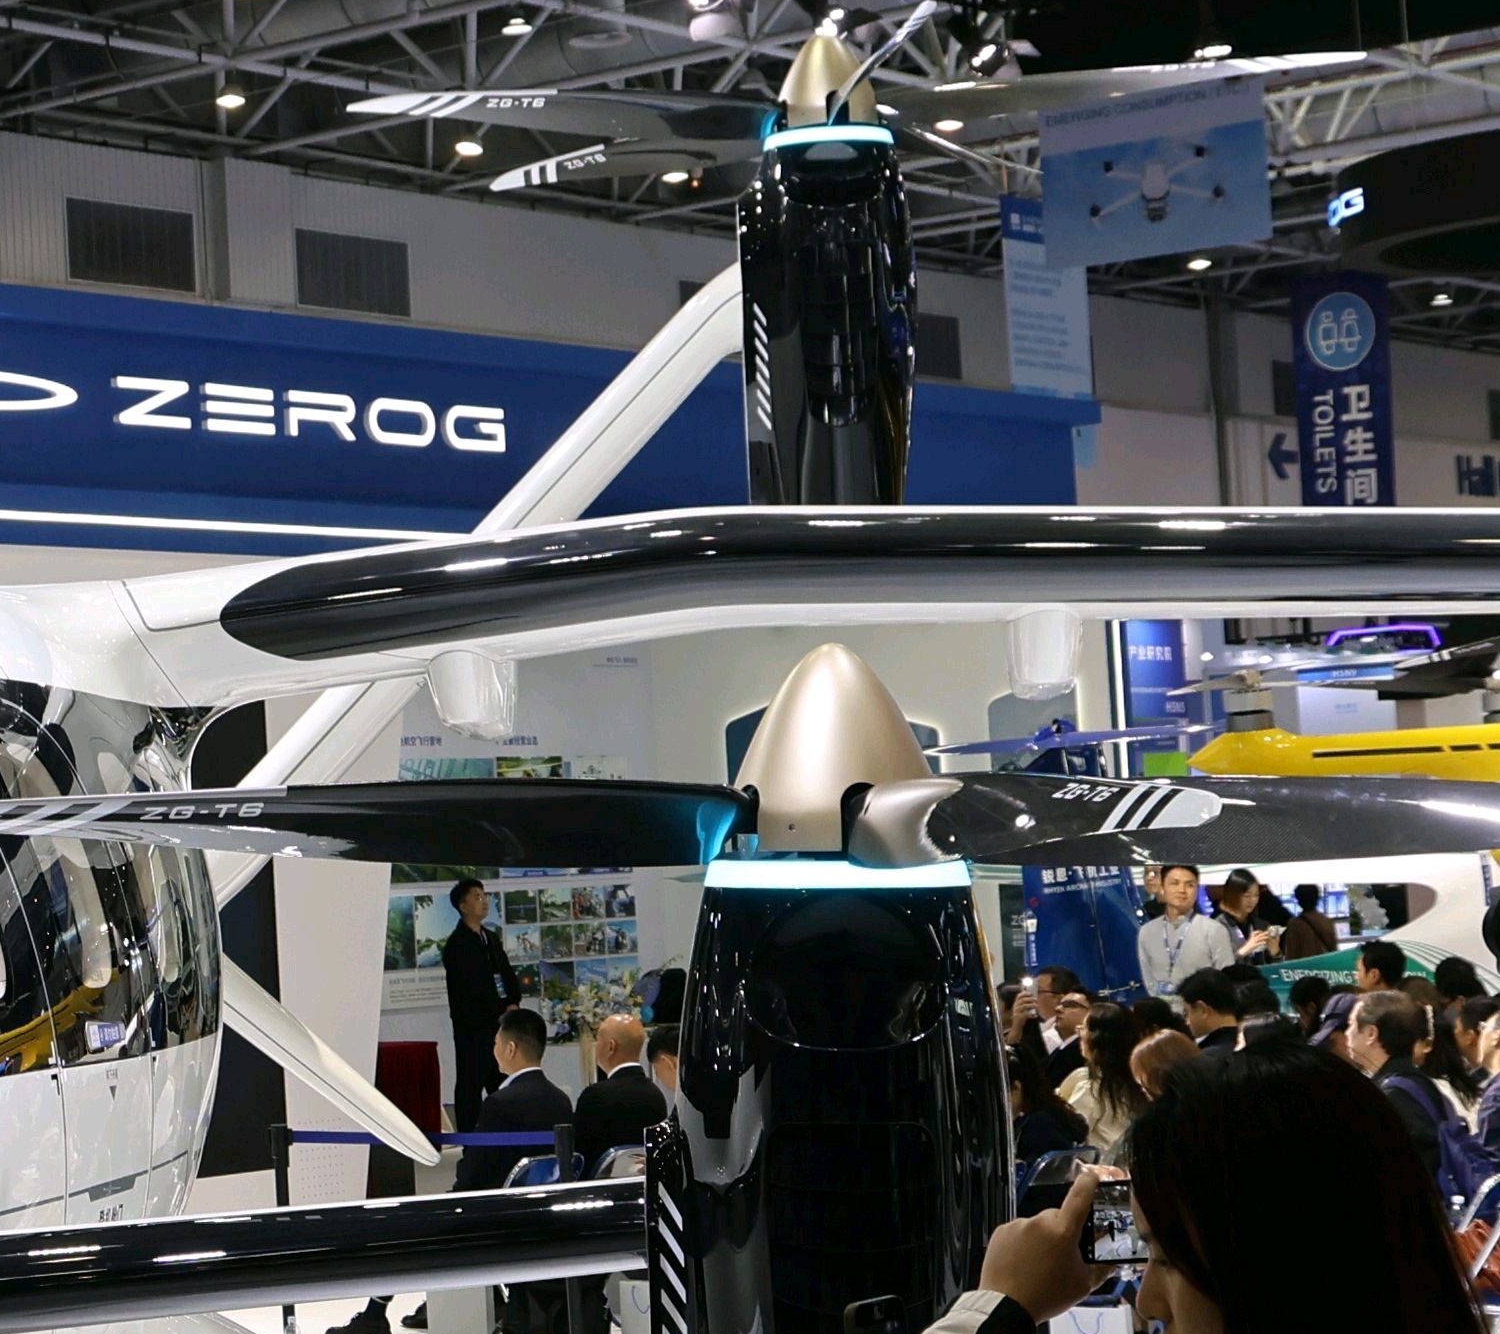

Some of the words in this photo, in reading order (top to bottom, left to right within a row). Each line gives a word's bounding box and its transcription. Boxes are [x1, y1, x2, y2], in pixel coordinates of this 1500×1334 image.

[109, 374, 507, 453] ZEROG
[1312, 389, 1338, 494] TOILETS
[1340, 384, 1379, 505] 卫生间
[1455, 454, 1497, 498] Hall
[139, 802, 265, 821] ZG-T6
[1051, 782, 1115, 803] ZG-T6
